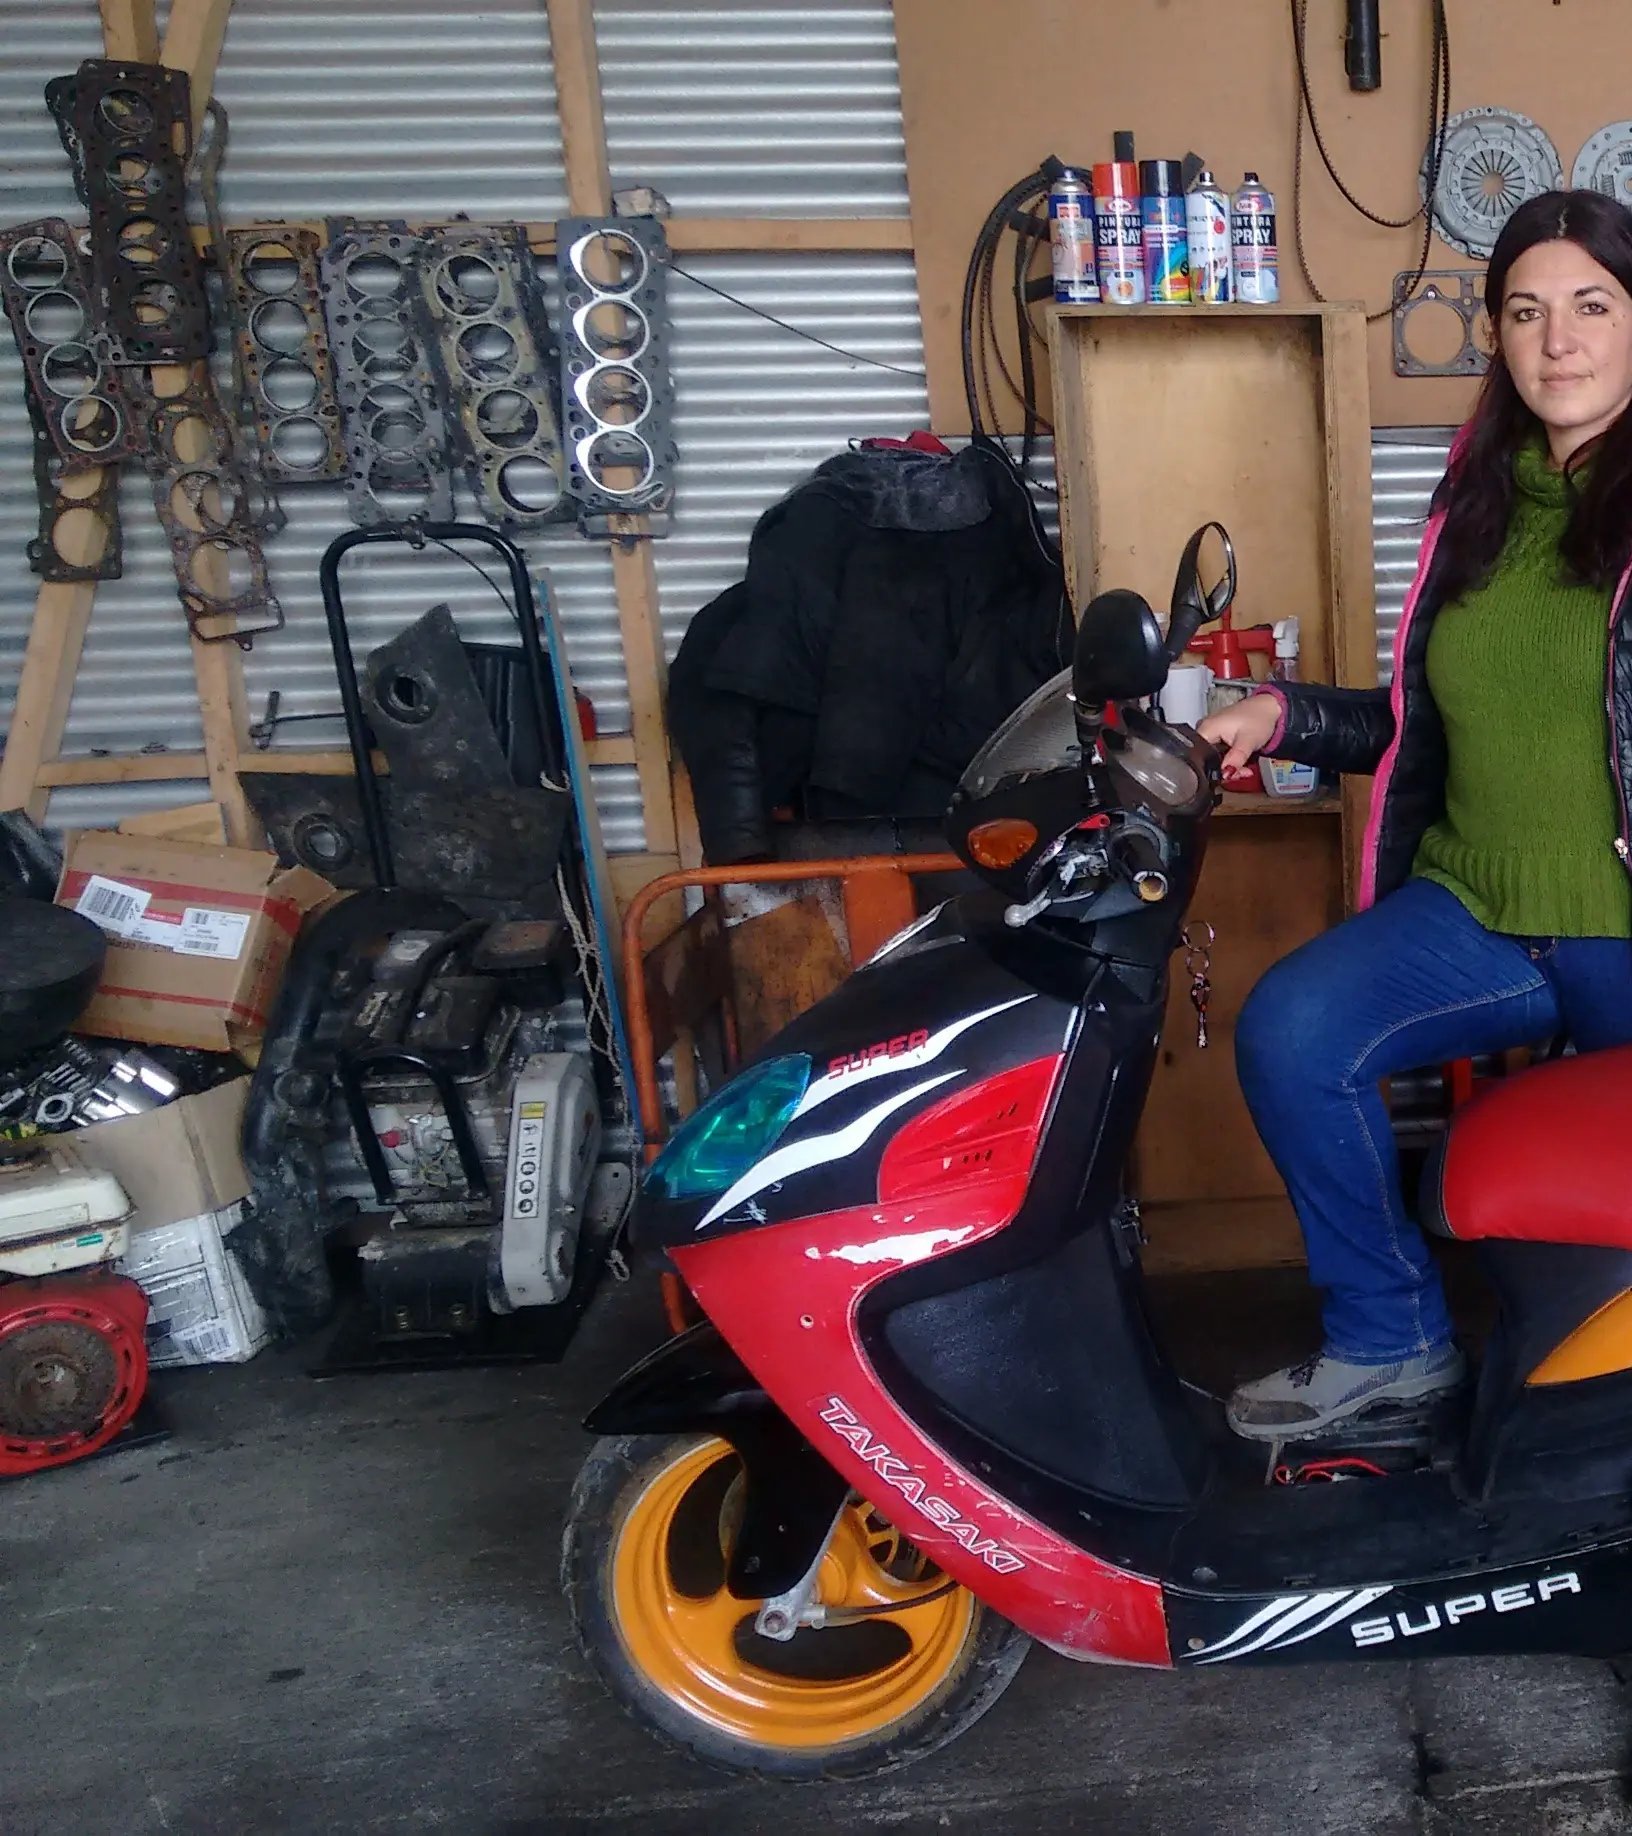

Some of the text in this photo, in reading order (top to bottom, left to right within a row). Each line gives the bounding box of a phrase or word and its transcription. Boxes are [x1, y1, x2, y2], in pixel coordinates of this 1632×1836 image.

[1099, 228, 1141, 245] SPRAY
[1232, 228, 1271, 245] SPRAY
[828, 1028, 930, 1080] SUPER
[818, 1396, 1026, 1575] TAKASAKI
[1350, 1572, 1582, 1648] SUPER
